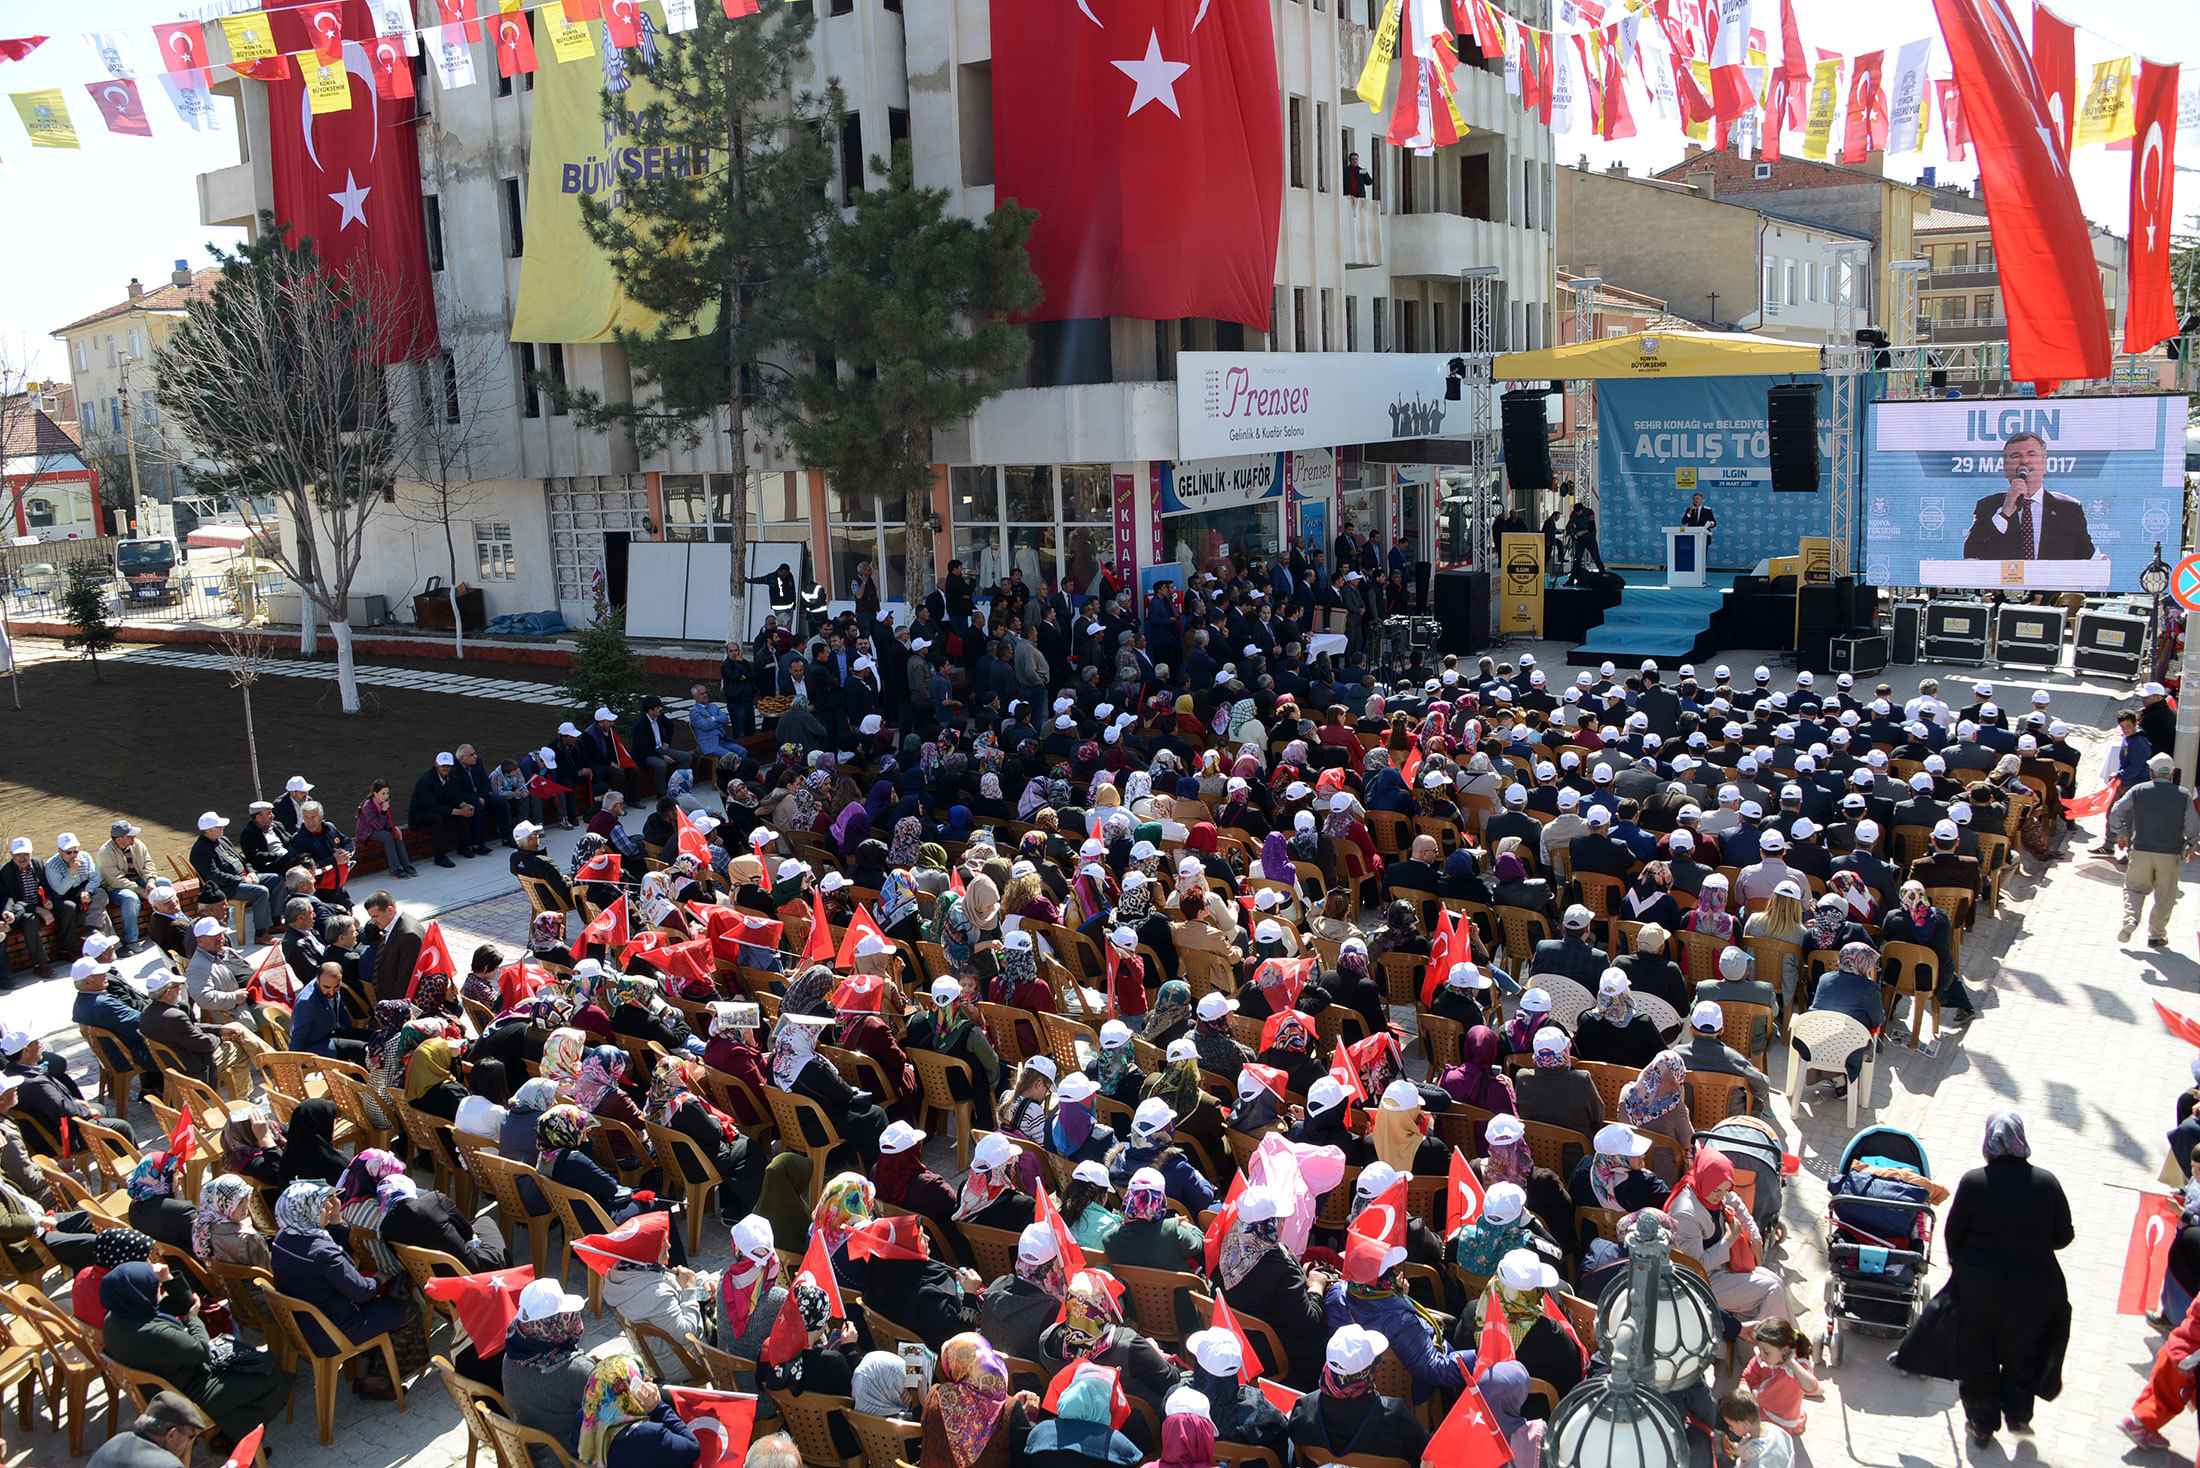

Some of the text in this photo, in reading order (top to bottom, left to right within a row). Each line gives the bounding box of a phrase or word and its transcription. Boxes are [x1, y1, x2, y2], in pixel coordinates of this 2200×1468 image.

[1223, 366, 1309, 418] Prenses
[1229, 424, 1305, 441] Gelinlik & Kuaför Salonu
[1634, 419, 1764, 432] ŞEHİR KONAĞI ve BELEDİYE
[1967, 409, 2061, 441] ILGIN
[1634, 433, 1723, 465] AÇILIŞ
[1293, 454, 1332, 482] Prenses
[1722, 469, 1748, 479] ILGIN
[1951, 456, 2076, 473] 29 MA 017
[1178, 467, 1226, 498] GELİNLİK
[1233, 463, 1271, 491] KUAFÖR
[1868, 526, 1901, 535] YÜKŞEHİR
[1120, 508, 1132, 610] KUAFÖ
